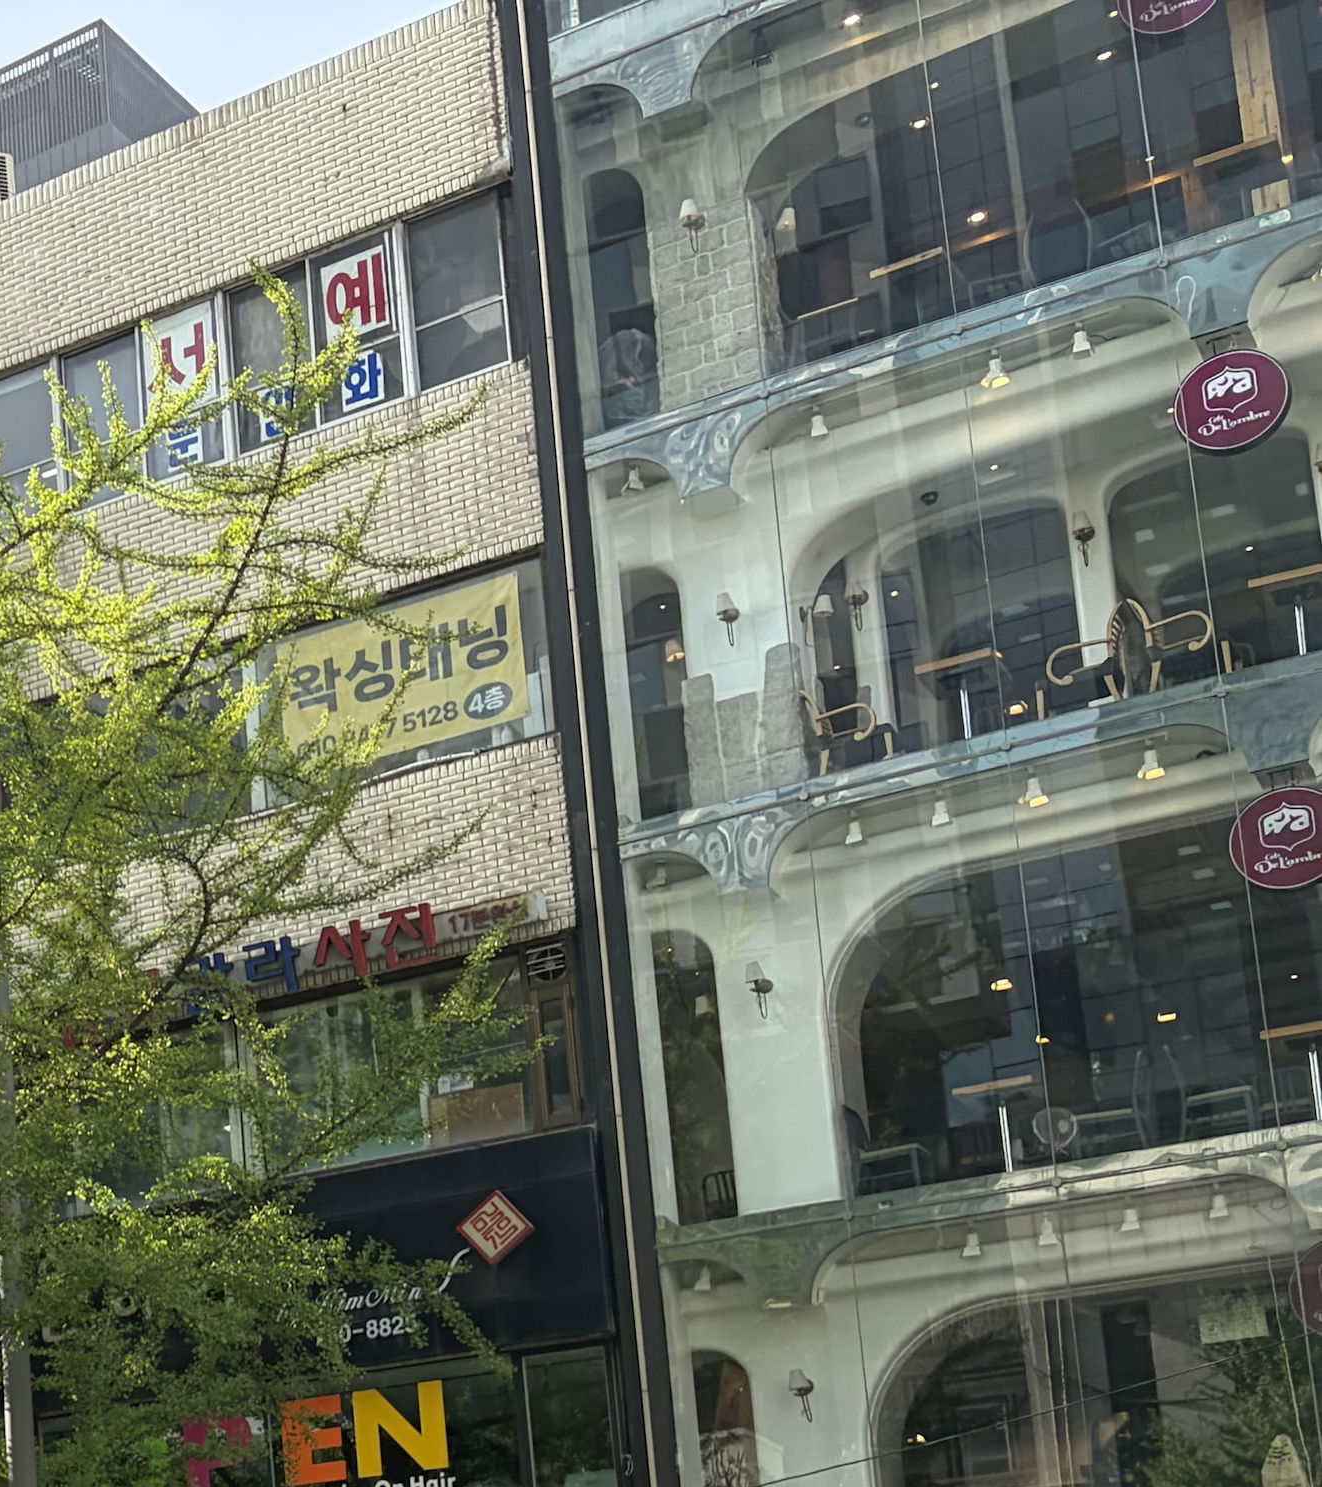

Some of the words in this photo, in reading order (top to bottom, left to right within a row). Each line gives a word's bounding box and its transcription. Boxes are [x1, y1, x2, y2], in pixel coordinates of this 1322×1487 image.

[325, 251, 388, 327] 예
[344, 350, 382, 407] 화
[403, 700, 459, 733] 5128
[468, 685, 506, 715] 4층
[313, 902, 440, 978] 사진
